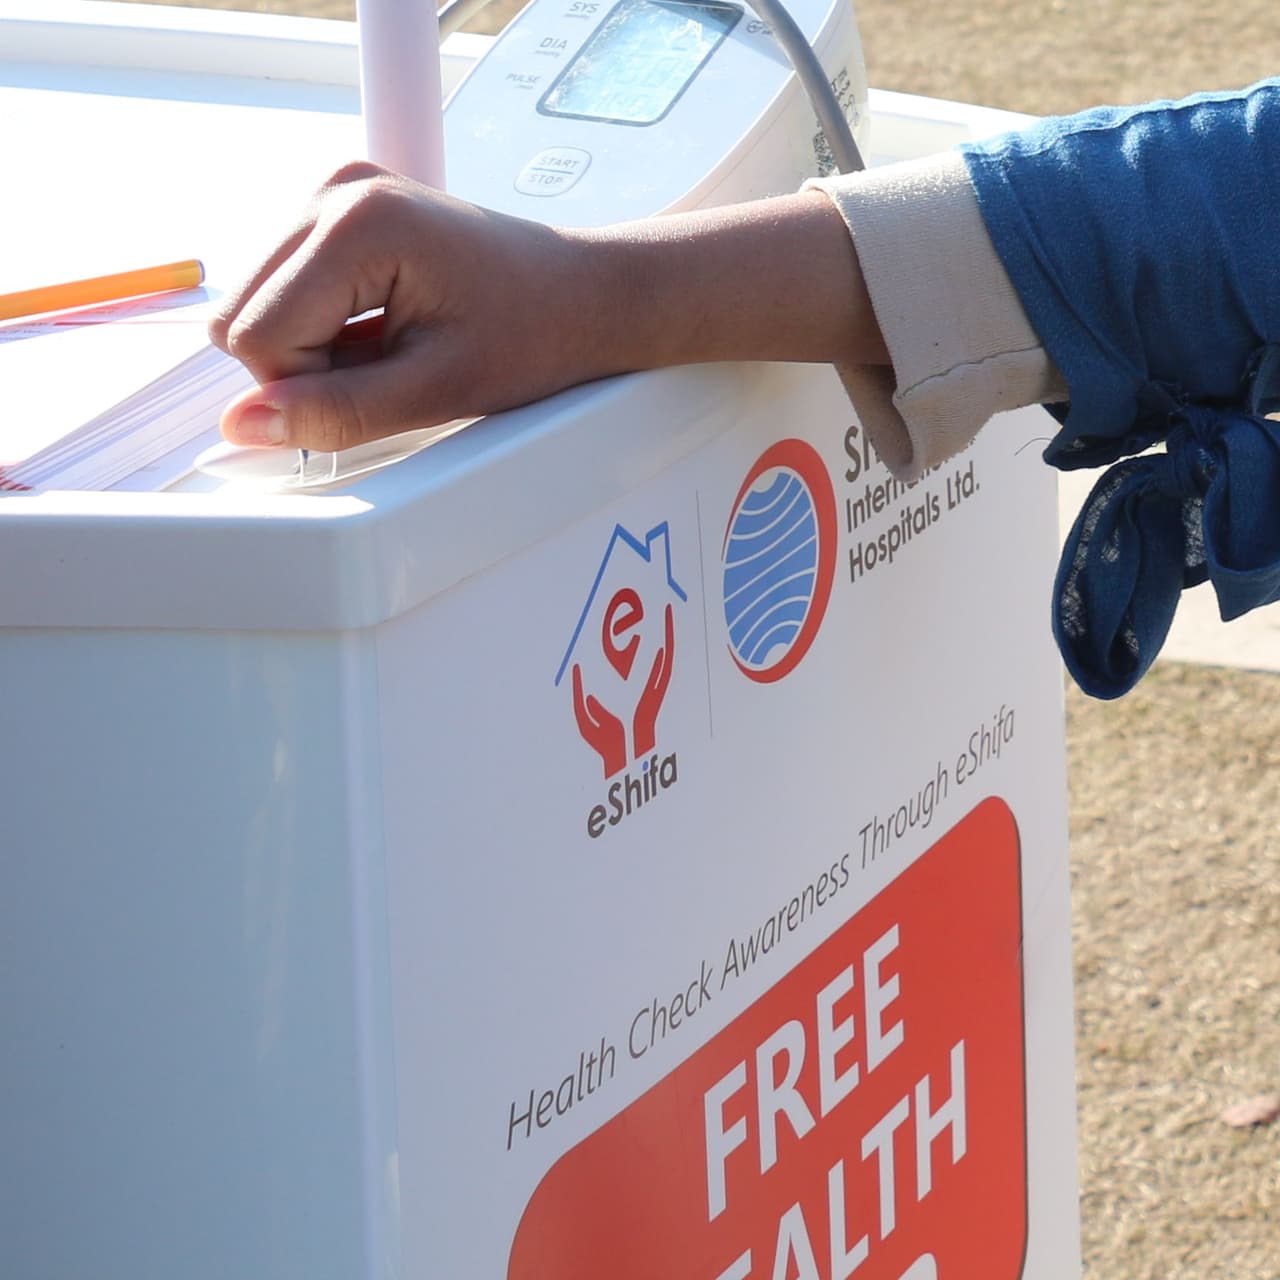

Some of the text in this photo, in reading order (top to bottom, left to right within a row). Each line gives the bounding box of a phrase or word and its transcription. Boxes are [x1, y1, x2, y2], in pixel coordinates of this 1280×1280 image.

[540, 37, 568, 49] DIA
[569, 1, 600, 13] SYS
[528, 173, 563, 184] STOP
[538, 156, 580, 168] START
[848, 491, 941, 583] Hospitals
[946, 460, 980, 511] Ltd.
[587, 752, 678, 838] eShifa
[506, 704, 1015, 1151] Health Check Awareness Through eShifa
[704, 922, 905, 1224] FREE
[712, 1039, 967, 1280] ALTH
